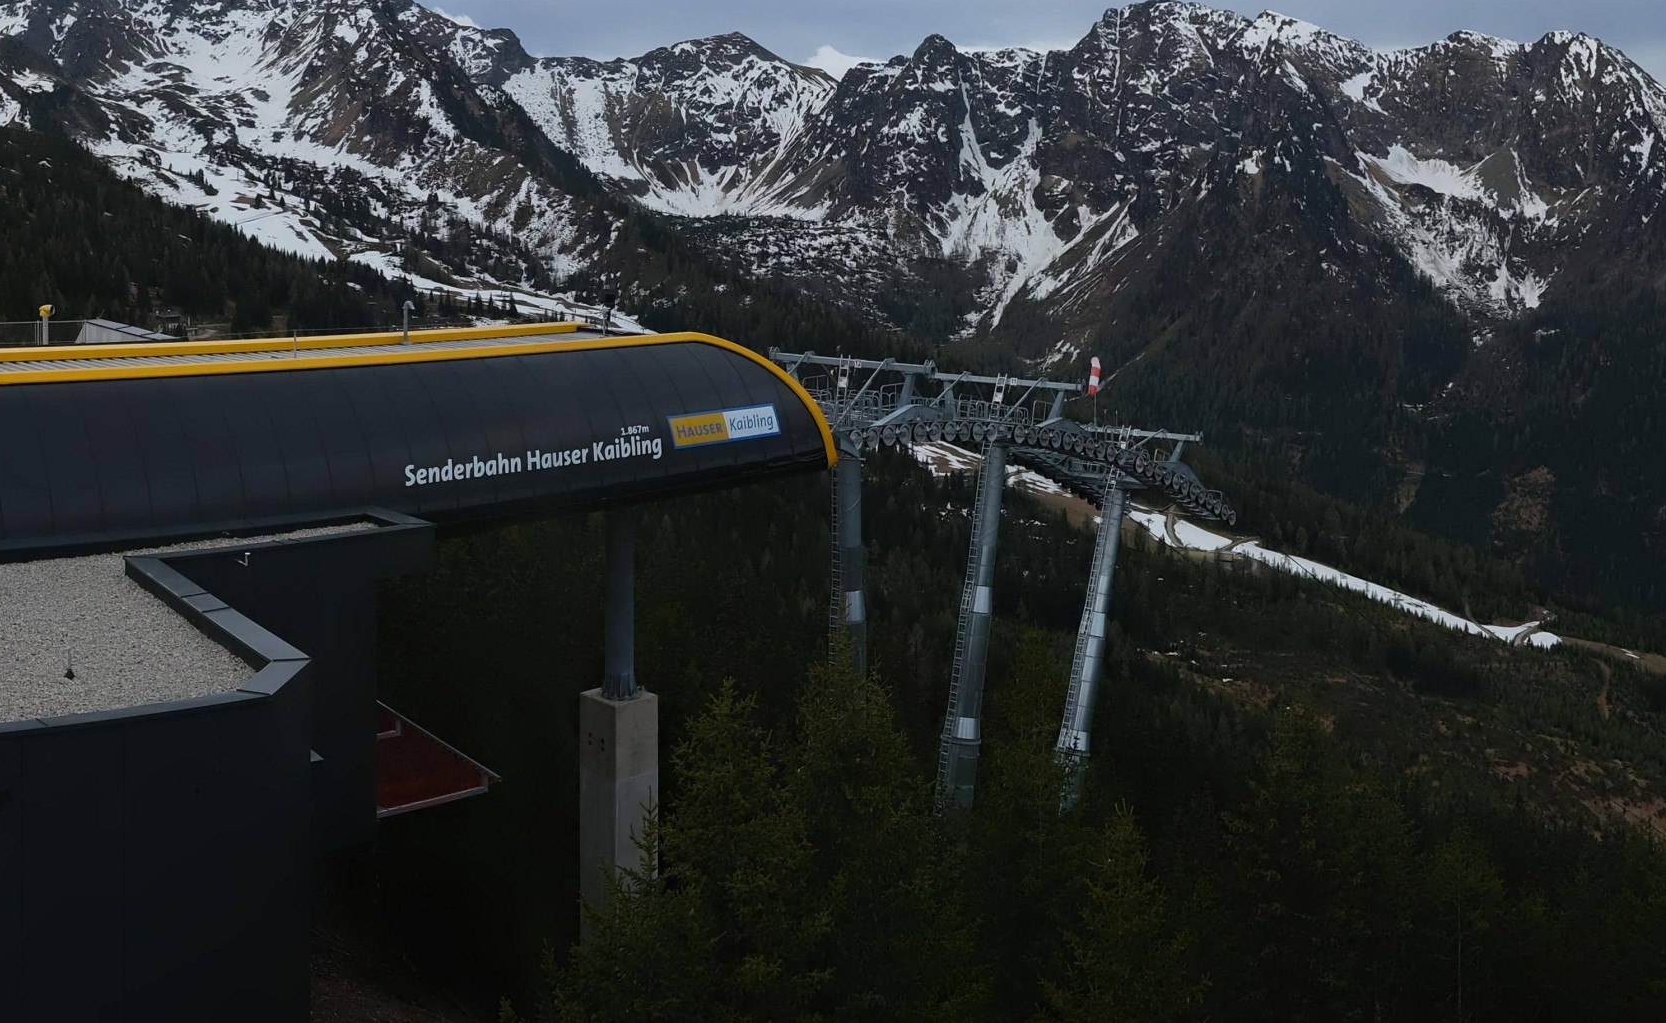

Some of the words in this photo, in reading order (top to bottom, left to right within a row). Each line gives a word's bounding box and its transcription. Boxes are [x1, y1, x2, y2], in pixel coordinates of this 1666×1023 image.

[620, 424, 649, 436] 1.867m
[676, 422, 723, 439] HAUSER
[729, 414, 774, 432] Kaibling
[404, 452, 521, 487] Senderbahn
[526, 447, 588, 471] Hauser
[593, 435, 663, 462] Kaibling
